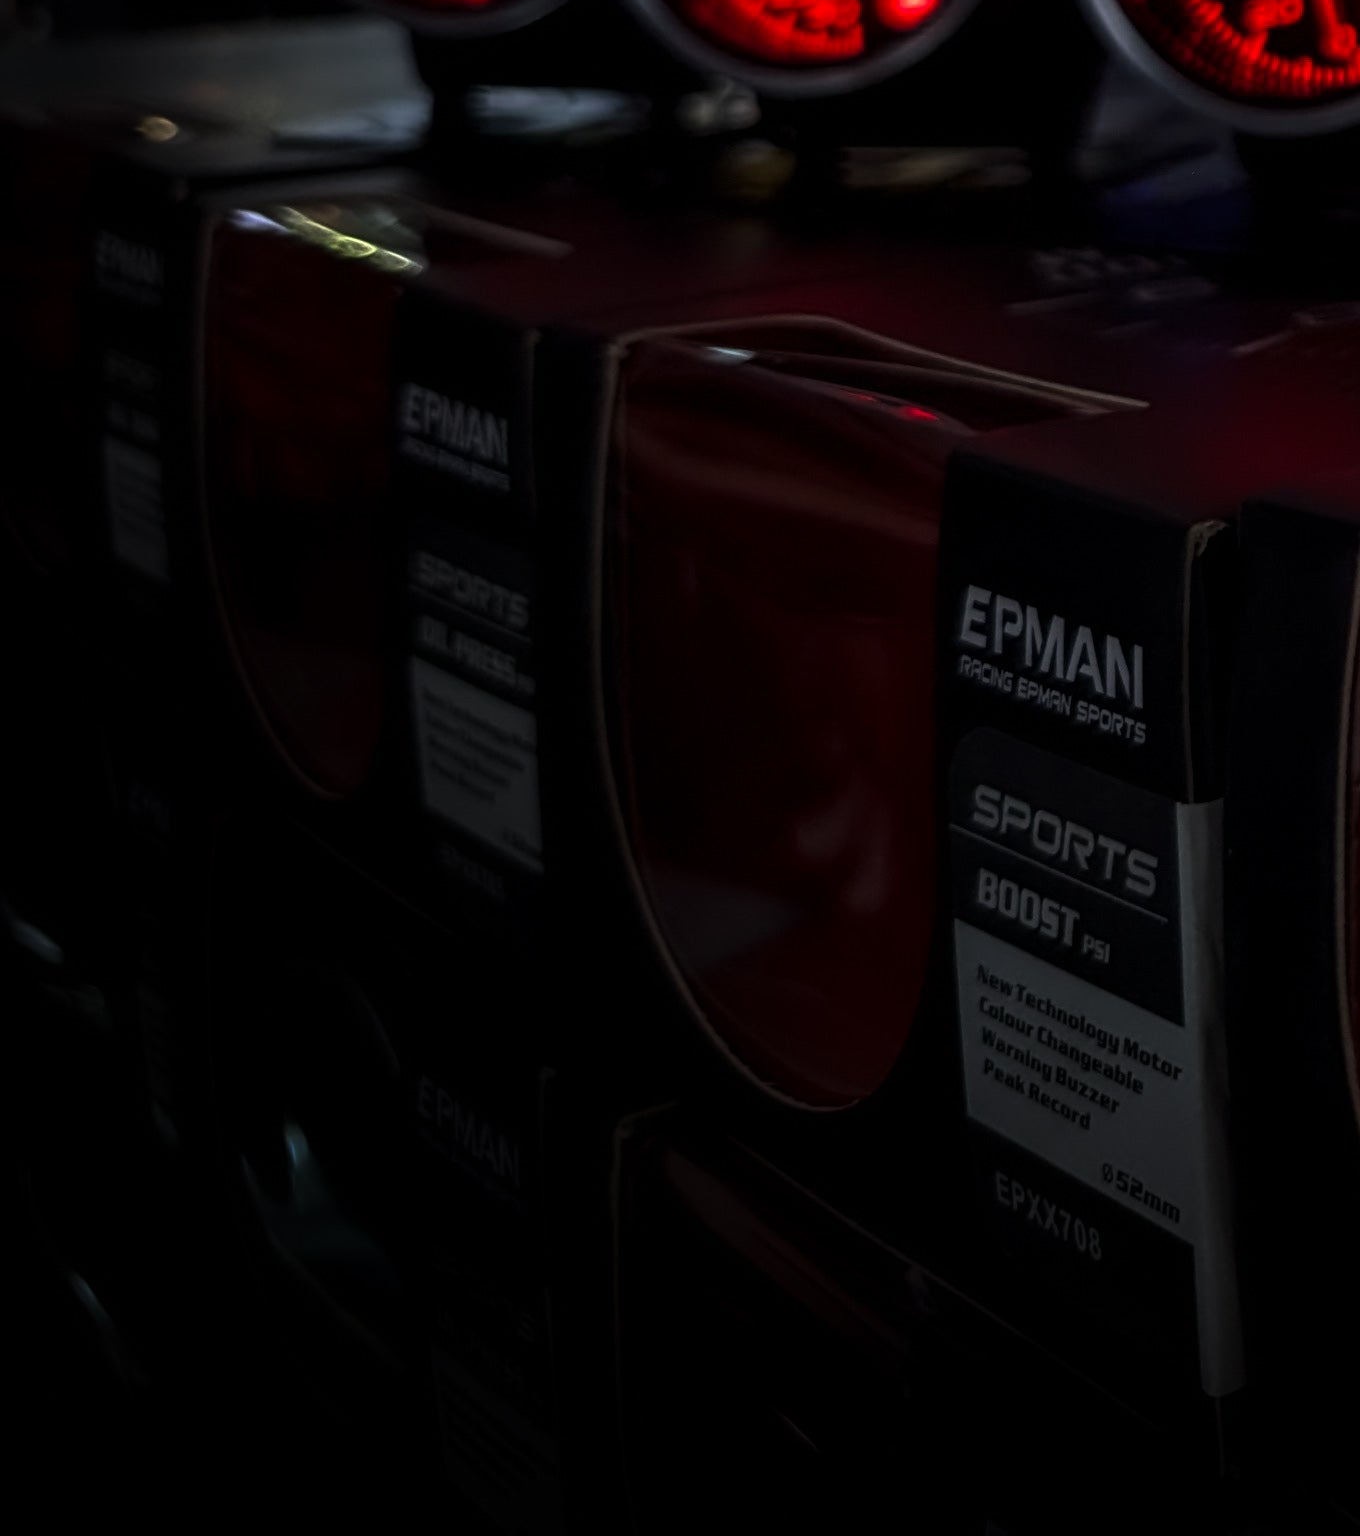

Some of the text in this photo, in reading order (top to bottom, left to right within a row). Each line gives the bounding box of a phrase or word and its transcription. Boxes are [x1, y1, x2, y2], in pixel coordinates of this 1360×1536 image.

[958, 584, 1144, 711] EPMAN
[957, 654, 1147, 745] RACING EPMAN SPORTS
[973, 784, 1160, 899] SPORTS
[976, 868, 1080, 948] BOOST
[978, 966, 1182, 1081] New Technology Motor
[979, 997, 1144, 1095] Colour Changeable
[982, 1028, 1120, 1113] Warning Buzzer
[984, 1058, 1091, 1130] Peak Record
